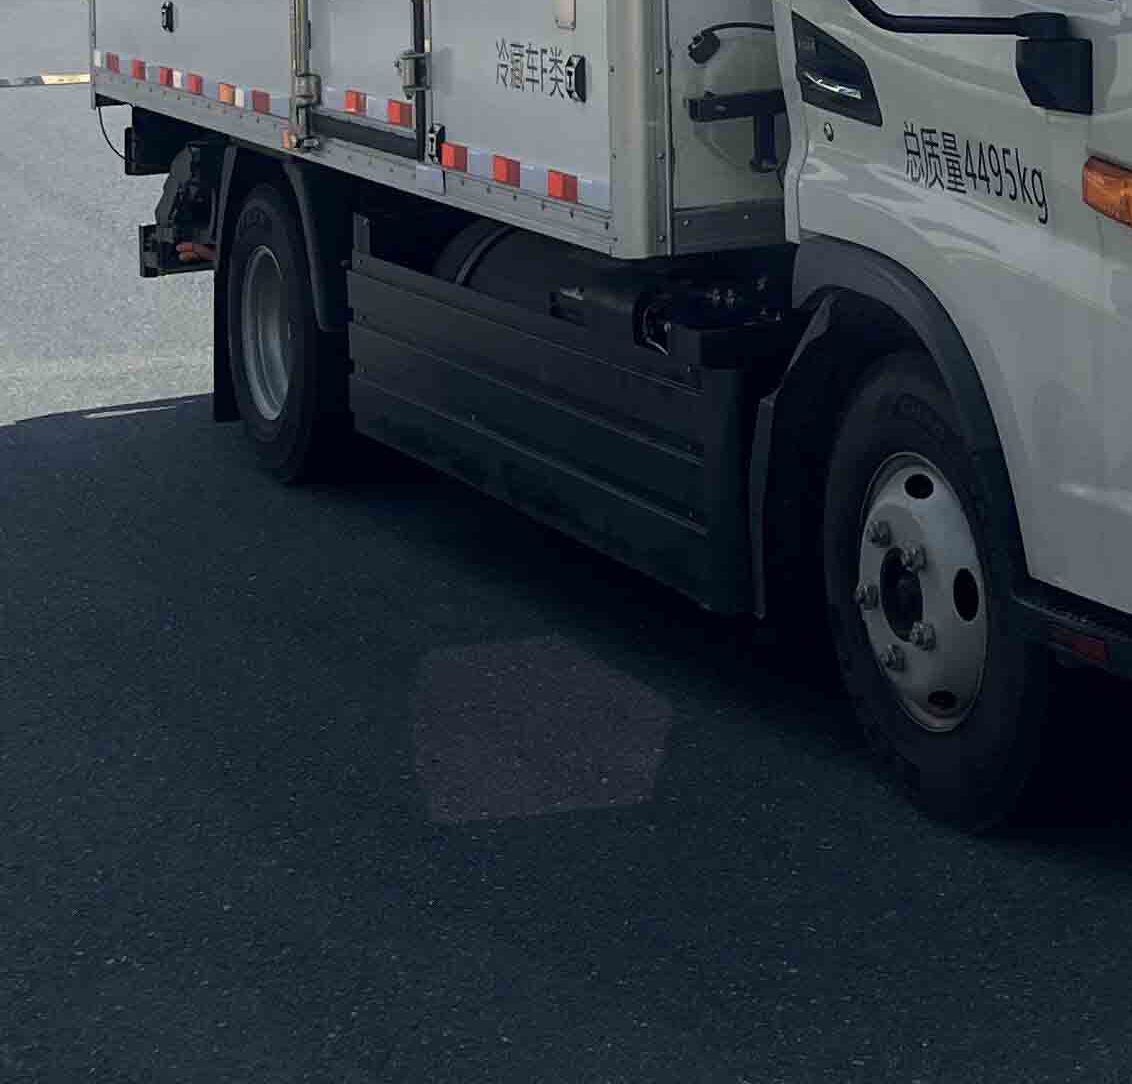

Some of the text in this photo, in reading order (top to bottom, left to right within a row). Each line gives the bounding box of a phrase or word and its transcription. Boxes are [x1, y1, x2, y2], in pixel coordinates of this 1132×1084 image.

[496, 38, 565, 100] 冷藏车F类
[903, 121, 1049, 224] 总质量4495kg
